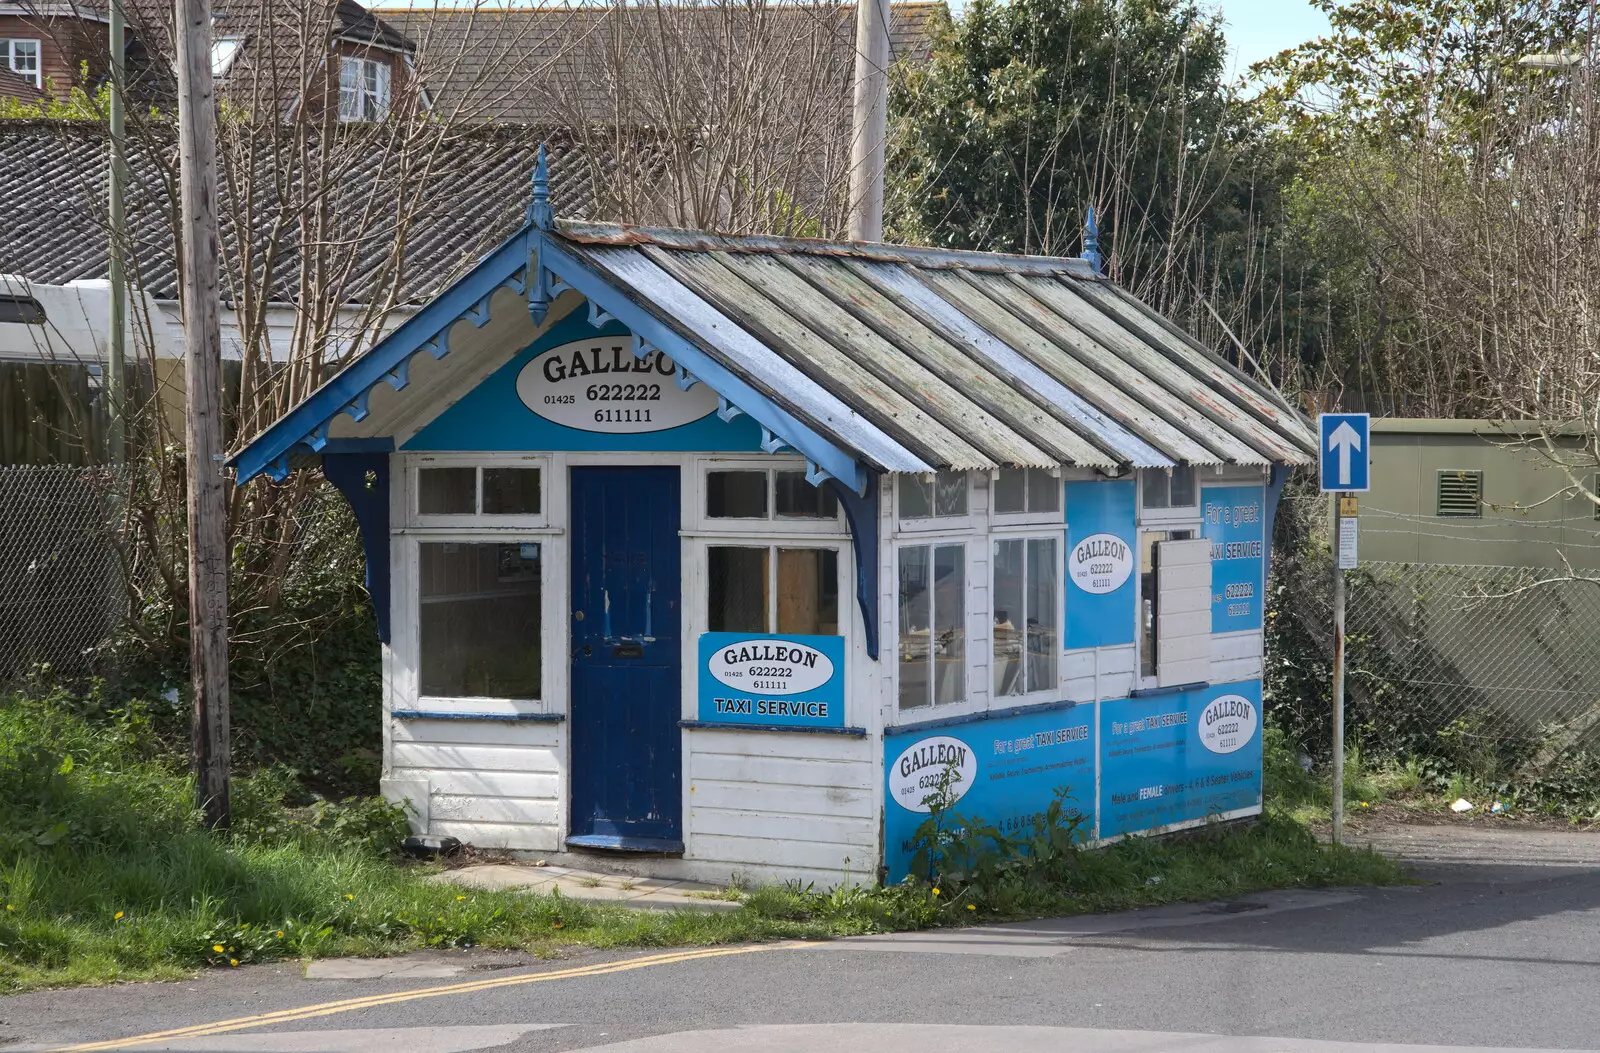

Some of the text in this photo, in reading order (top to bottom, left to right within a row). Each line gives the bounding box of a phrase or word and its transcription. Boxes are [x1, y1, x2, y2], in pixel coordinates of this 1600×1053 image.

[543, 346, 676, 383] GALLEO
[544, 384, 661, 404] 01425 622222
[594, 409, 652, 422] 611111
[1205, 501, 1259, 528] For a great
[1077, 540, 1126, 564] GALLEON
[1210, 540, 1262, 560] AXI SERVICE
[1090, 563, 1113, 574] 622222
[1092, 579, 1110, 587] 611111
[1225, 582, 1253, 599] 622222
[724, 645, 818, 668] GALLEON
[749, 666, 792, 678] 622222
[753, 680, 787, 689] 611111
[714, 699, 828, 717] TAXI SERVICE
[1205, 701, 1250, 726] GALLEON
[1145, 715, 1160, 729] TAXI
[1162, 712, 1187, 727] SERVICE
[1217, 722, 1239, 735] 622222
[993, 739, 1006, 755] For
[1035, 730, 1055, 747] TAXI
[1056, 725, 1088, 744] SERVICE
[901, 744, 966, 778] GALLEON
[901, 786, 915, 796] 01425
[1112, 793, 1126, 805] Male
[1127, 791, 1138, 804] and
[1139, 784, 1163, 800] FEMALE
[1211, 773, 1229, 786] Seater
[1231, 769, 1254, 783] Vehicles
[1020, 815, 1025, 828] 8
